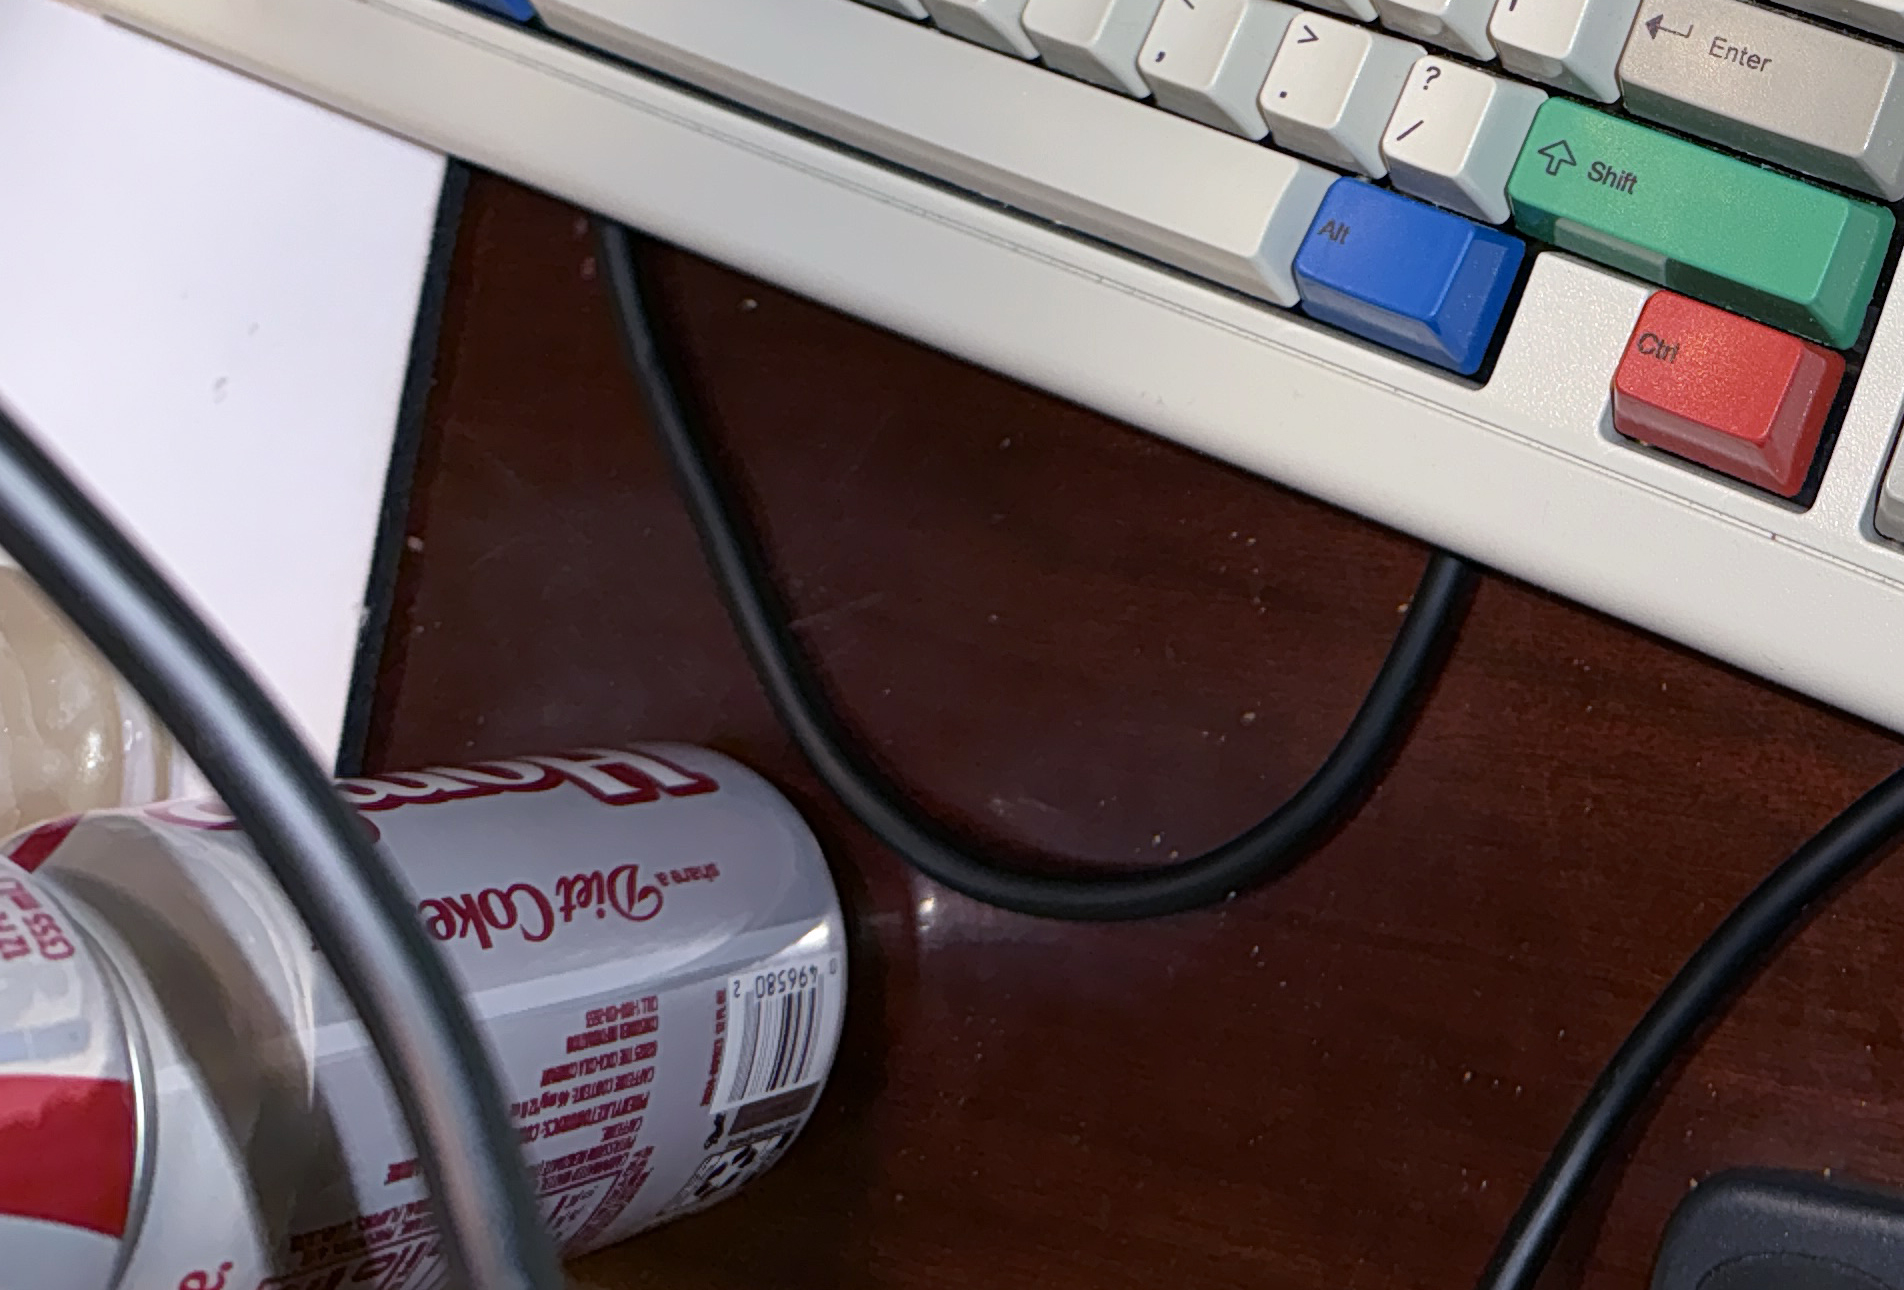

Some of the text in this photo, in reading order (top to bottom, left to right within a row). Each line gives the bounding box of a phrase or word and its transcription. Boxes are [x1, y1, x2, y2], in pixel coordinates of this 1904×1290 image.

[1297, 25, 1319, 44] >
[1708, 36, 1773, 72] Enter
[1423, 65, 1442, 91] ?
[1396, 120, 1424, 142] /
[1587, 160, 1638, 195] Shift
[1317, 219, 1351, 245] Alt
[1636, 331, 1682, 362] Ctrl
[555, 863, 664, 922] Diet
[418, 882, 555, 950] Coke
[733, 979, 742, 999] 2
[754, 964, 819, 1000] 496580
